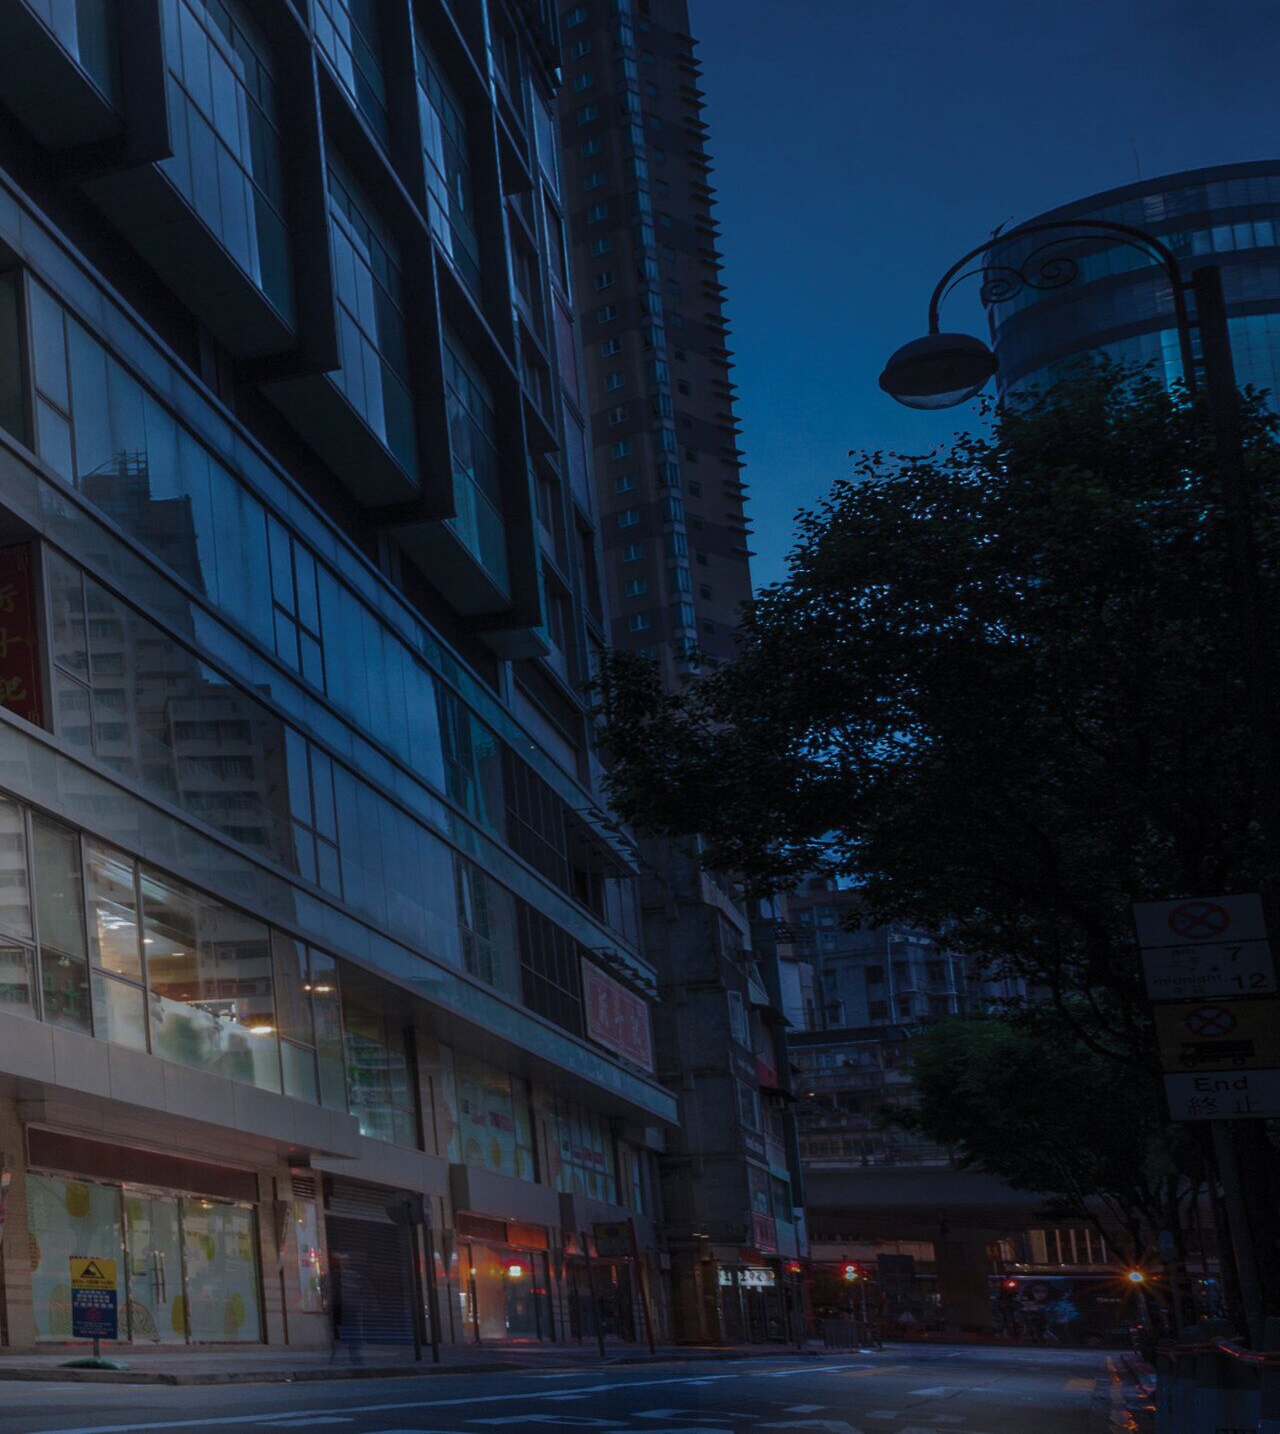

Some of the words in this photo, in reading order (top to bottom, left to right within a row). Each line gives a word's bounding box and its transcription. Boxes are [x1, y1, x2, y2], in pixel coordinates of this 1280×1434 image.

[1224, 946, 1242, 962] 7
[1152, 972, 1223, 986] midnight
[1231, 973, 1267, 990] 12
[1194, 1076, 1248, 1092] End
[1188, 1094, 1264, 1116] 終止
